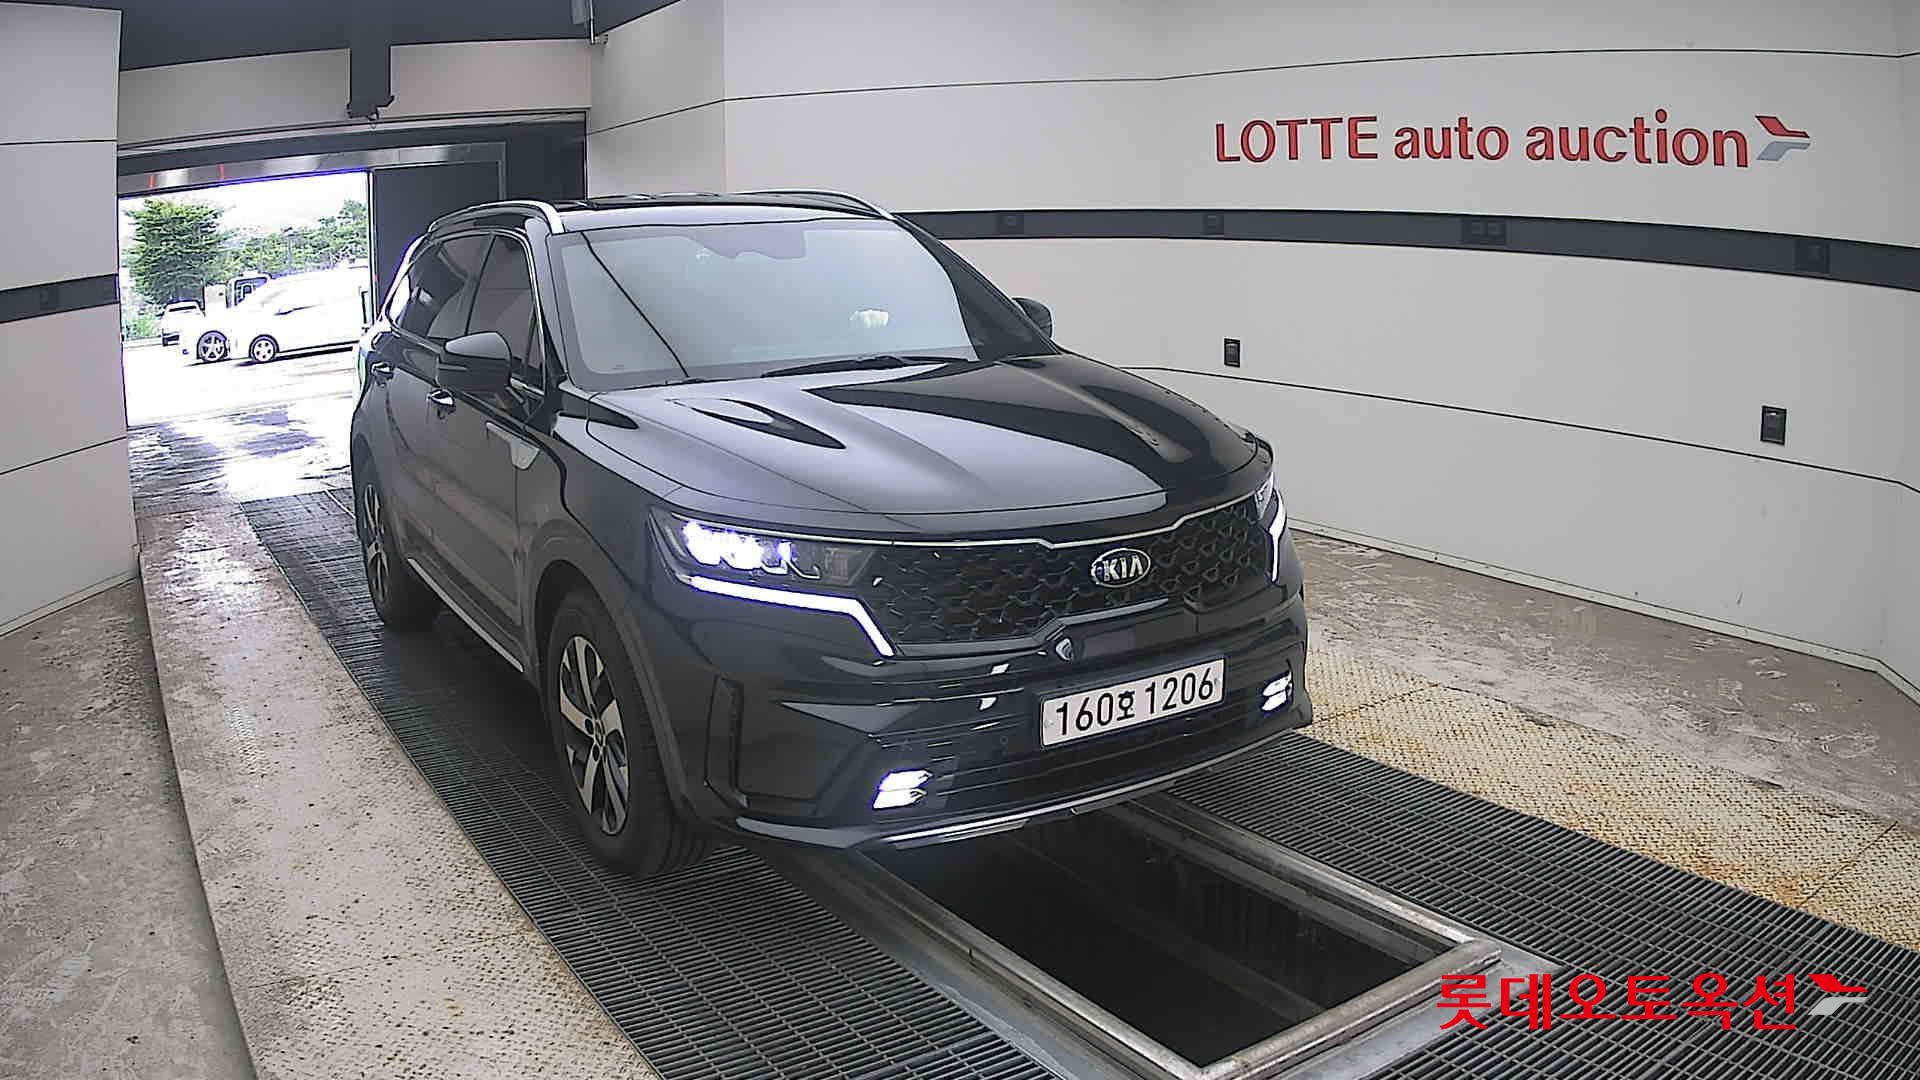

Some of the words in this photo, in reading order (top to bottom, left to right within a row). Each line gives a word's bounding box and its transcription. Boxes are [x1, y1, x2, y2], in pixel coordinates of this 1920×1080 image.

[1215, 116, 1379, 163] LOTTE
[1393, 116, 1509, 161] auto
[1526, 108, 1749, 168] auction
[1103, 555, 1144, 581] KIA
[1056, 691, 1135, 735] 160호
[1145, 668, 1213, 714] 1206
